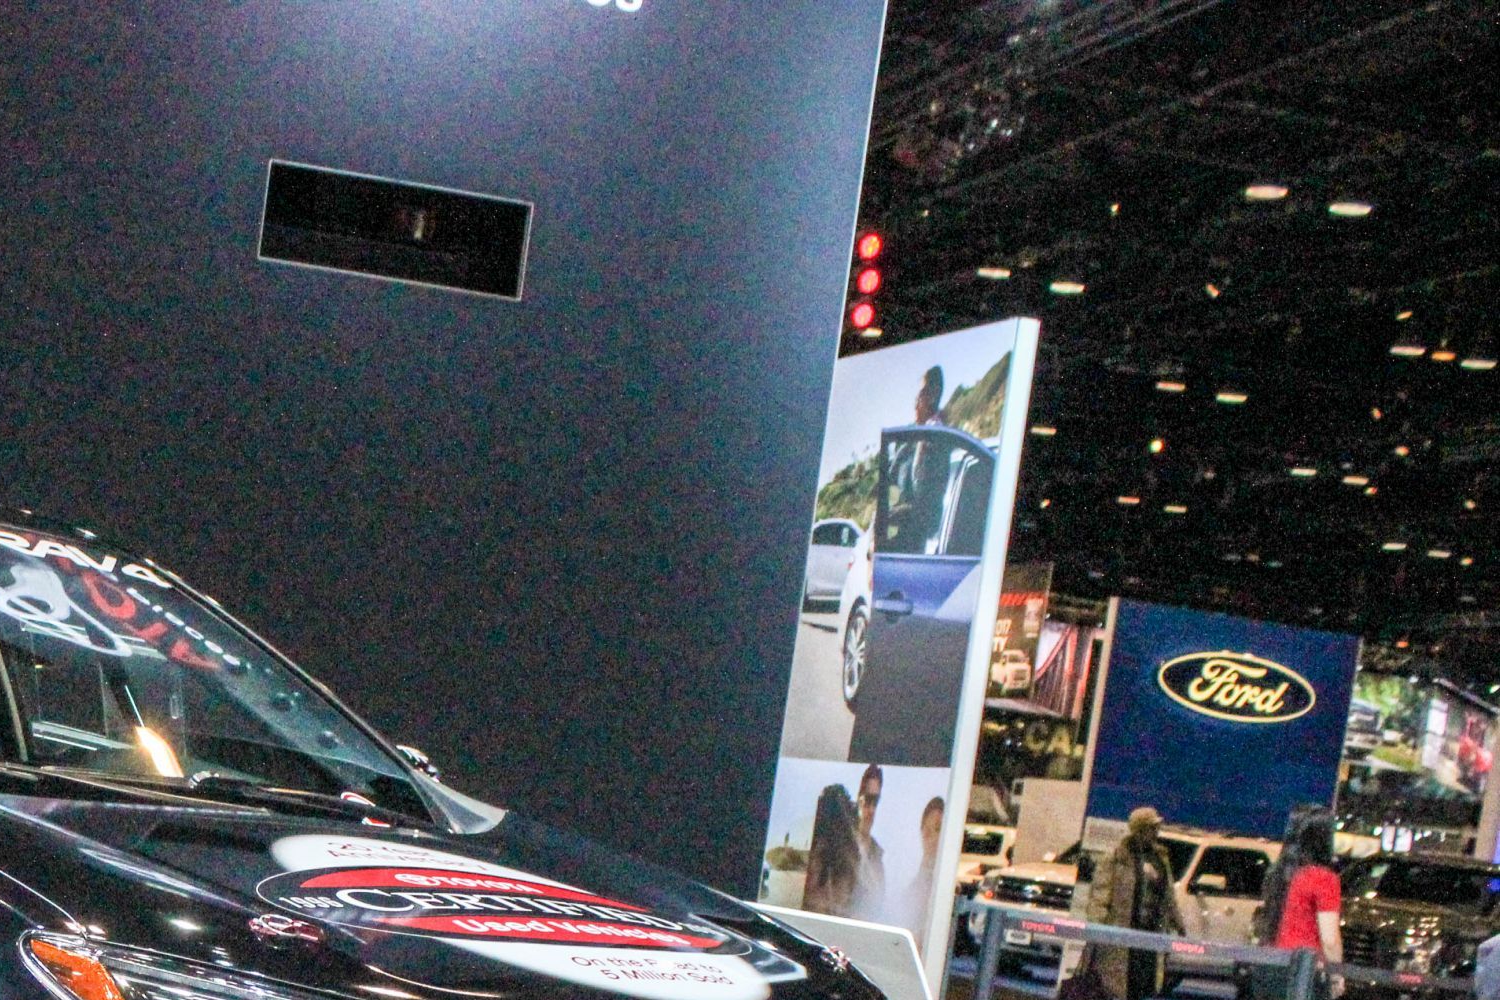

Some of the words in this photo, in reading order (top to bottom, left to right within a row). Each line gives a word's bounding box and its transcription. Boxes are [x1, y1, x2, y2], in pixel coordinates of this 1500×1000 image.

[1188, 659, 1290, 713] Ford
[435, 876, 544, 895] TOYOTA
[279, 896, 343, 909] 1996
[452, 918, 554, 933] Used
[549, 921, 691, 945] Vehicles
[571, 956, 605, 968] On
[606, 957, 644, 969] the
[600, 969, 619, 980] 5
[621, 969, 686, 983] Million
[688, 972, 735, 985] Sold
